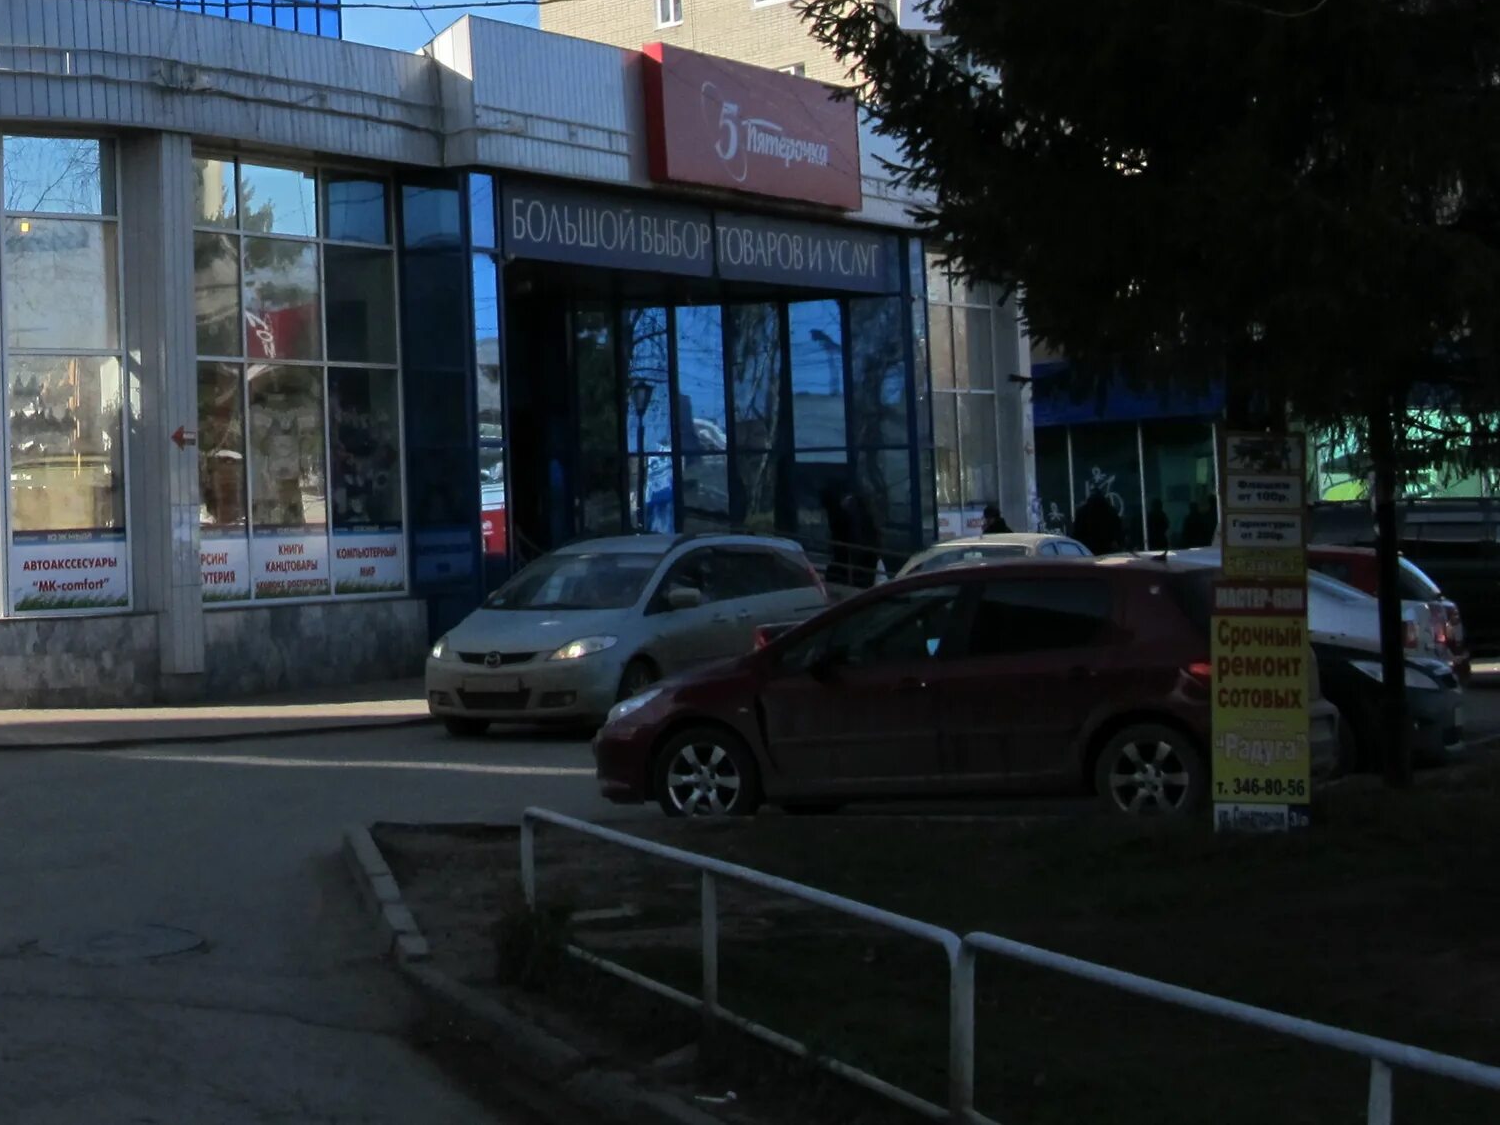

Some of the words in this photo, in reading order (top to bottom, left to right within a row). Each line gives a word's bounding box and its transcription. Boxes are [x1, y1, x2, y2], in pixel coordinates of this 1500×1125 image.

[511, 198, 635, 253] БОЛЬШОЙ
[640, 214, 711, 262] ВЫБОР
[715, 225, 804, 271] ТОВАРОВ
[807, 238, 823, 272] И
[828, 239, 880, 278] УСЛУГ
[277, 543, 304, 556] КНИГИ
[200, 570, 236, 584] УТЕРИЯ
[265, 559, 319, 574] КАНЦТОВАРЫ
[1217, 620, 1302, 652] Срочный
[1217, 655, 1303, 683] ремонт
[1217, 686, 1304, 710] сотовых
[1233, 777, 1305, 797] 346-80-56
